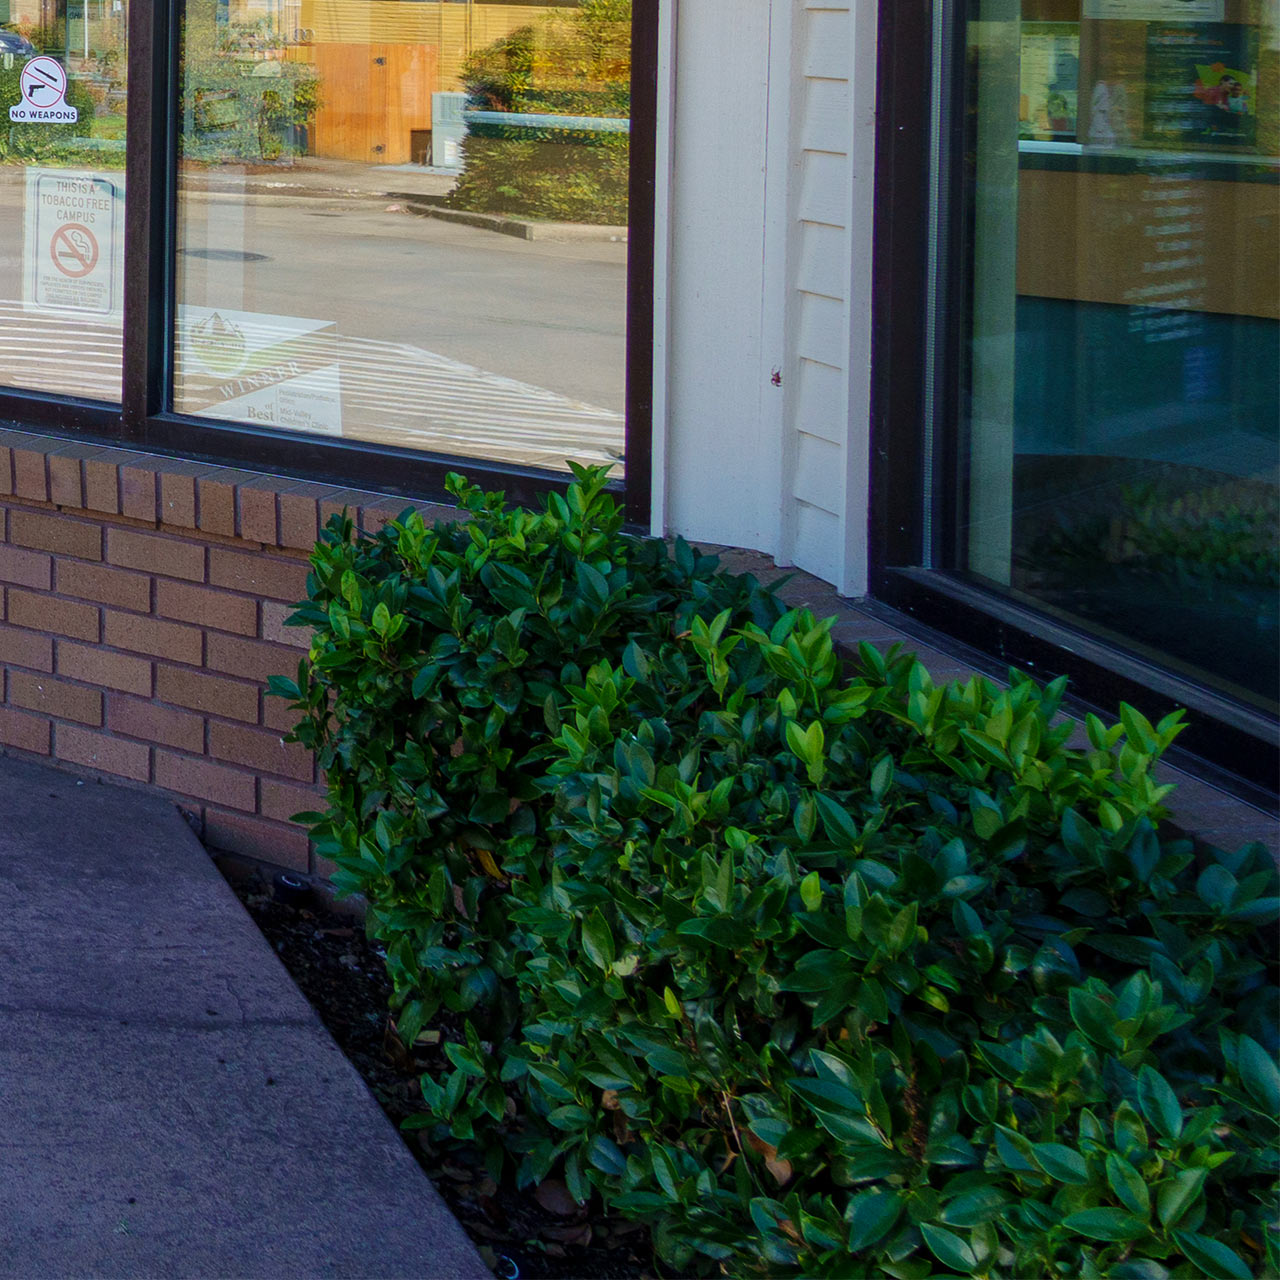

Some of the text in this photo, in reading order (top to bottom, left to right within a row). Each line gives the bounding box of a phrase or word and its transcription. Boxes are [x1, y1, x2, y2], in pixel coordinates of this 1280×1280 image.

[29, 111, 76, 120] WEAPONS
[57, 181, 96, 194] THIS IS A
[42, 194, 111, 211] TOBACCO FREE
[56, 210, 96, 224] CAMPUS
[219, 361, 302, 399] WINNER
[247, 405, 274, 422] Best
